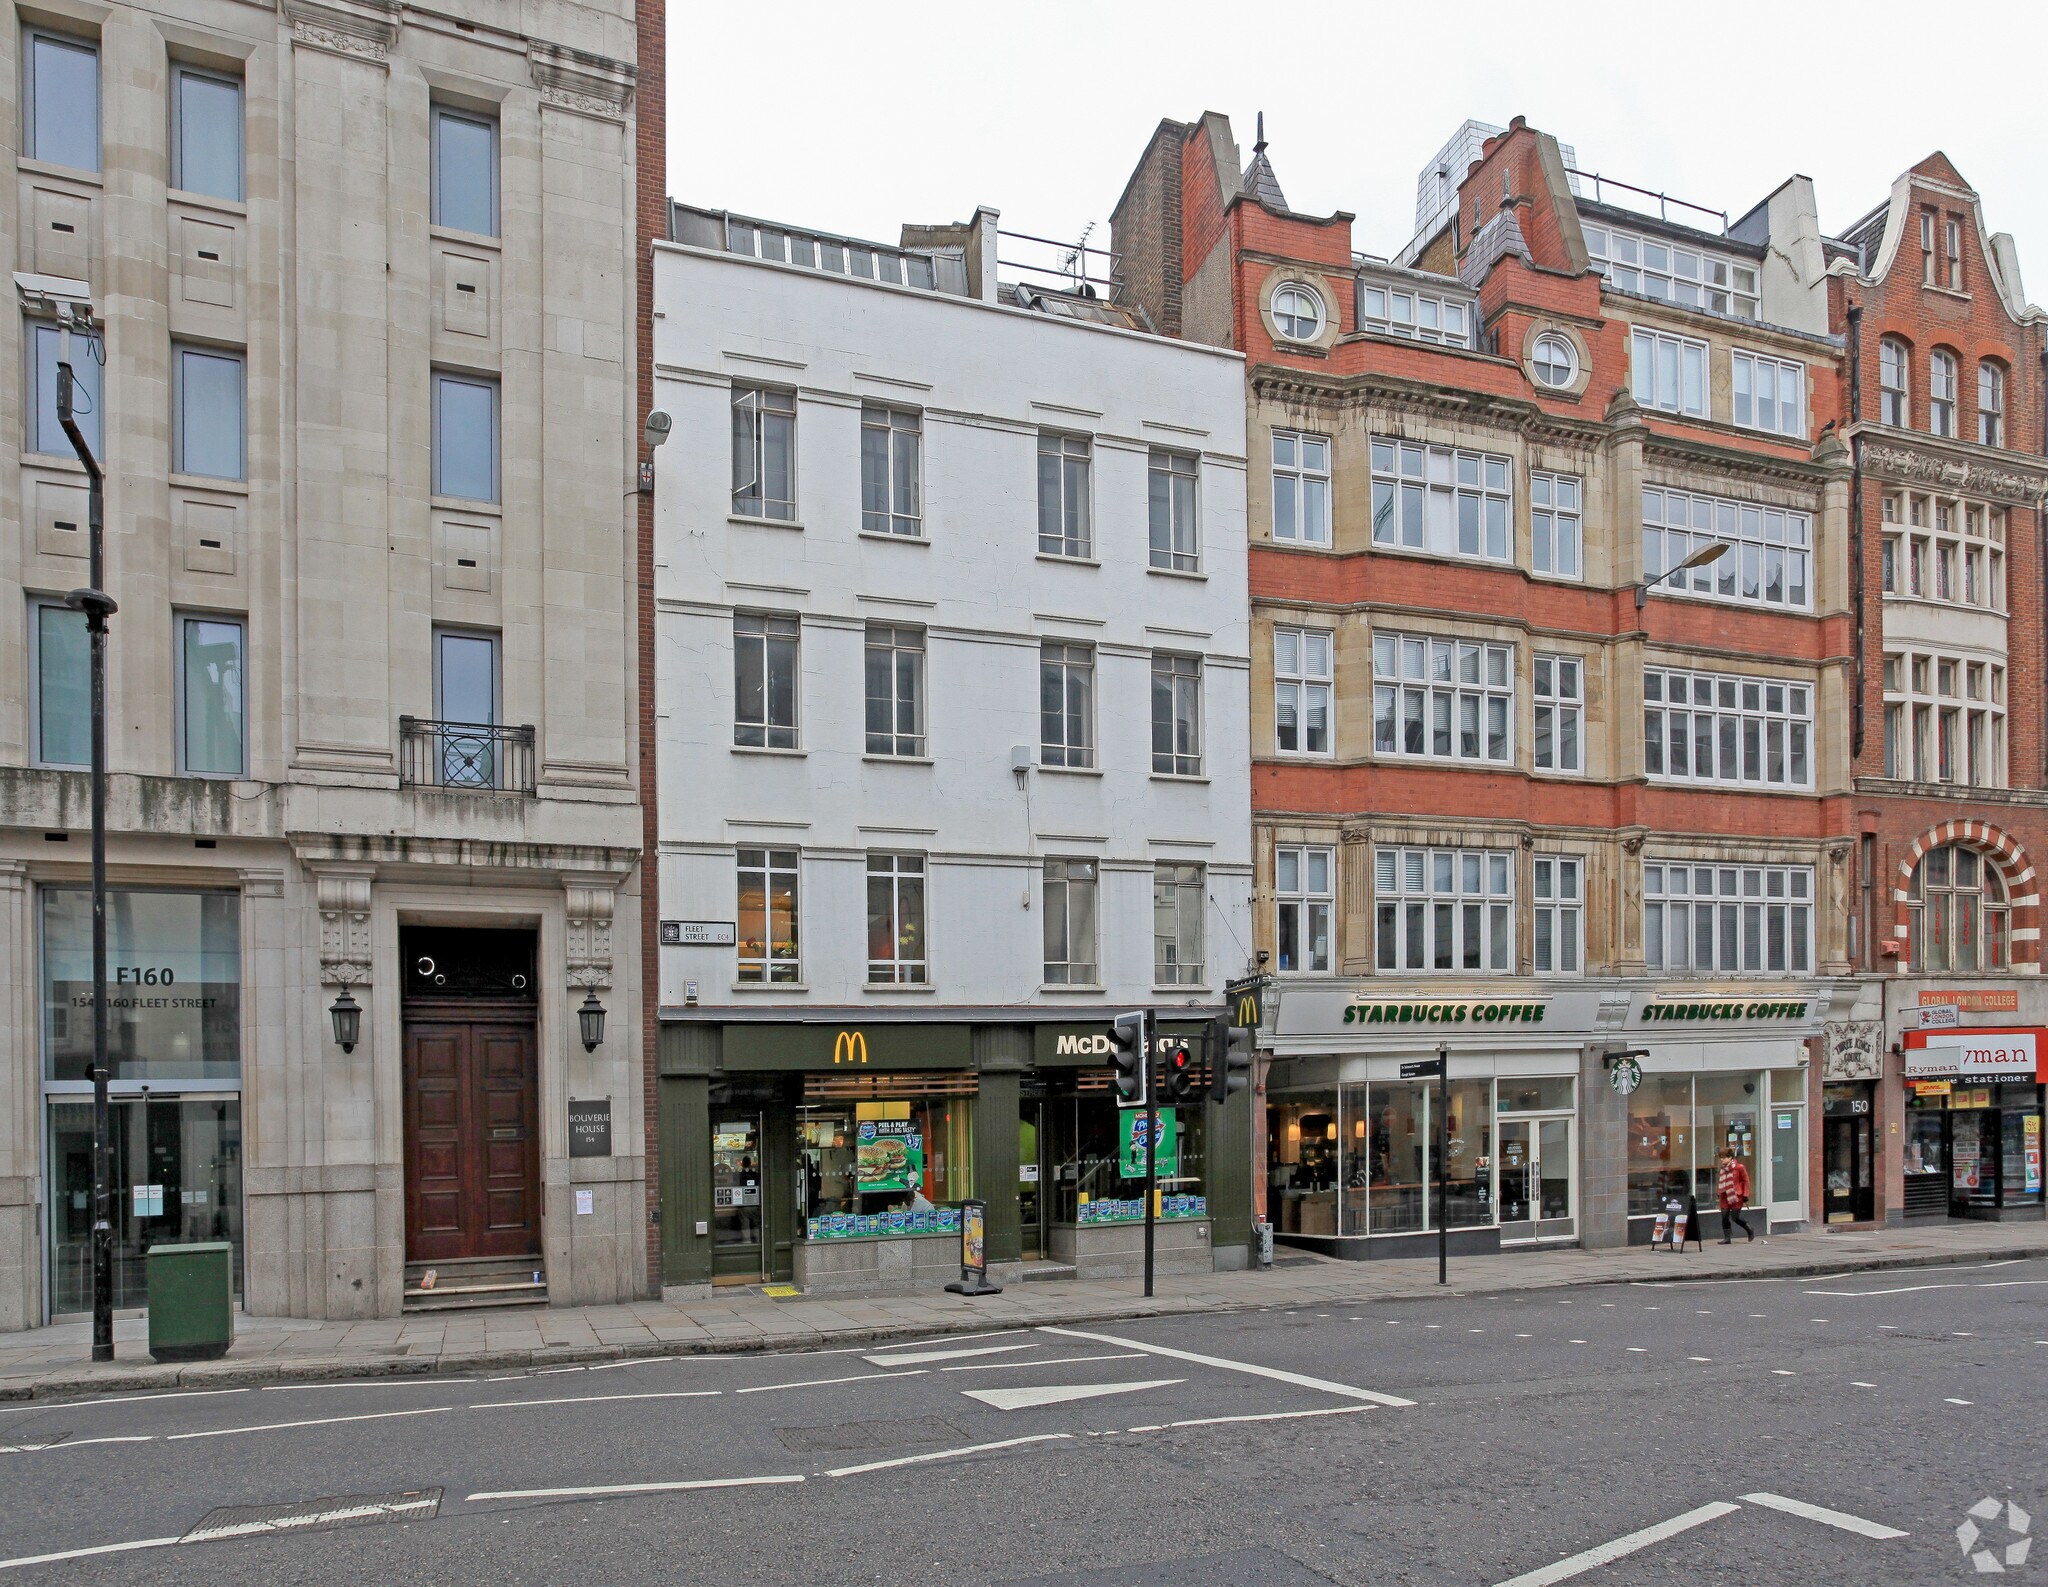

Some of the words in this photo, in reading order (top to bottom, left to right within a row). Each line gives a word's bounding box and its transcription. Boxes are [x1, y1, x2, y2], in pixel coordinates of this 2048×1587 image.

[685, 925, 704, 933] FLEET
[685, 933, 709, 941] STREET
[717, 933, 730, 941] EC4
[116, 966, 174, 987] F160
[132, 998, 168, 1009] FLEET
[172, 998, 217, 1009] STREET
[1921, 995, 1949, 1006] GLOBAL
[1952, 995, 1982, 1006] LONDON
[1984, 995, 2016, 1006] COLLEGE
[1343, 1004, 1467, 1023] STARBUCKS
[1471, 1004, 1546, 1022] COFFEE
[1641, 1003, 1744, 1020] STARBUCKS
[1746, 1002, 1808, 1019] COFFEE
[1835, 1038, 1854, 1055] THREE
[1844, 1052, 1862, 1063] COURT
[1907, 1064, 1959, 1074] Ryman
[1964, 1074, 2029, 1085] stationer
[1851, 1100, 1869, 1113] 150
[569, 1113, 611, 1123] BOUVERIE
[575, 1124, 605, 1134] HOUSE
